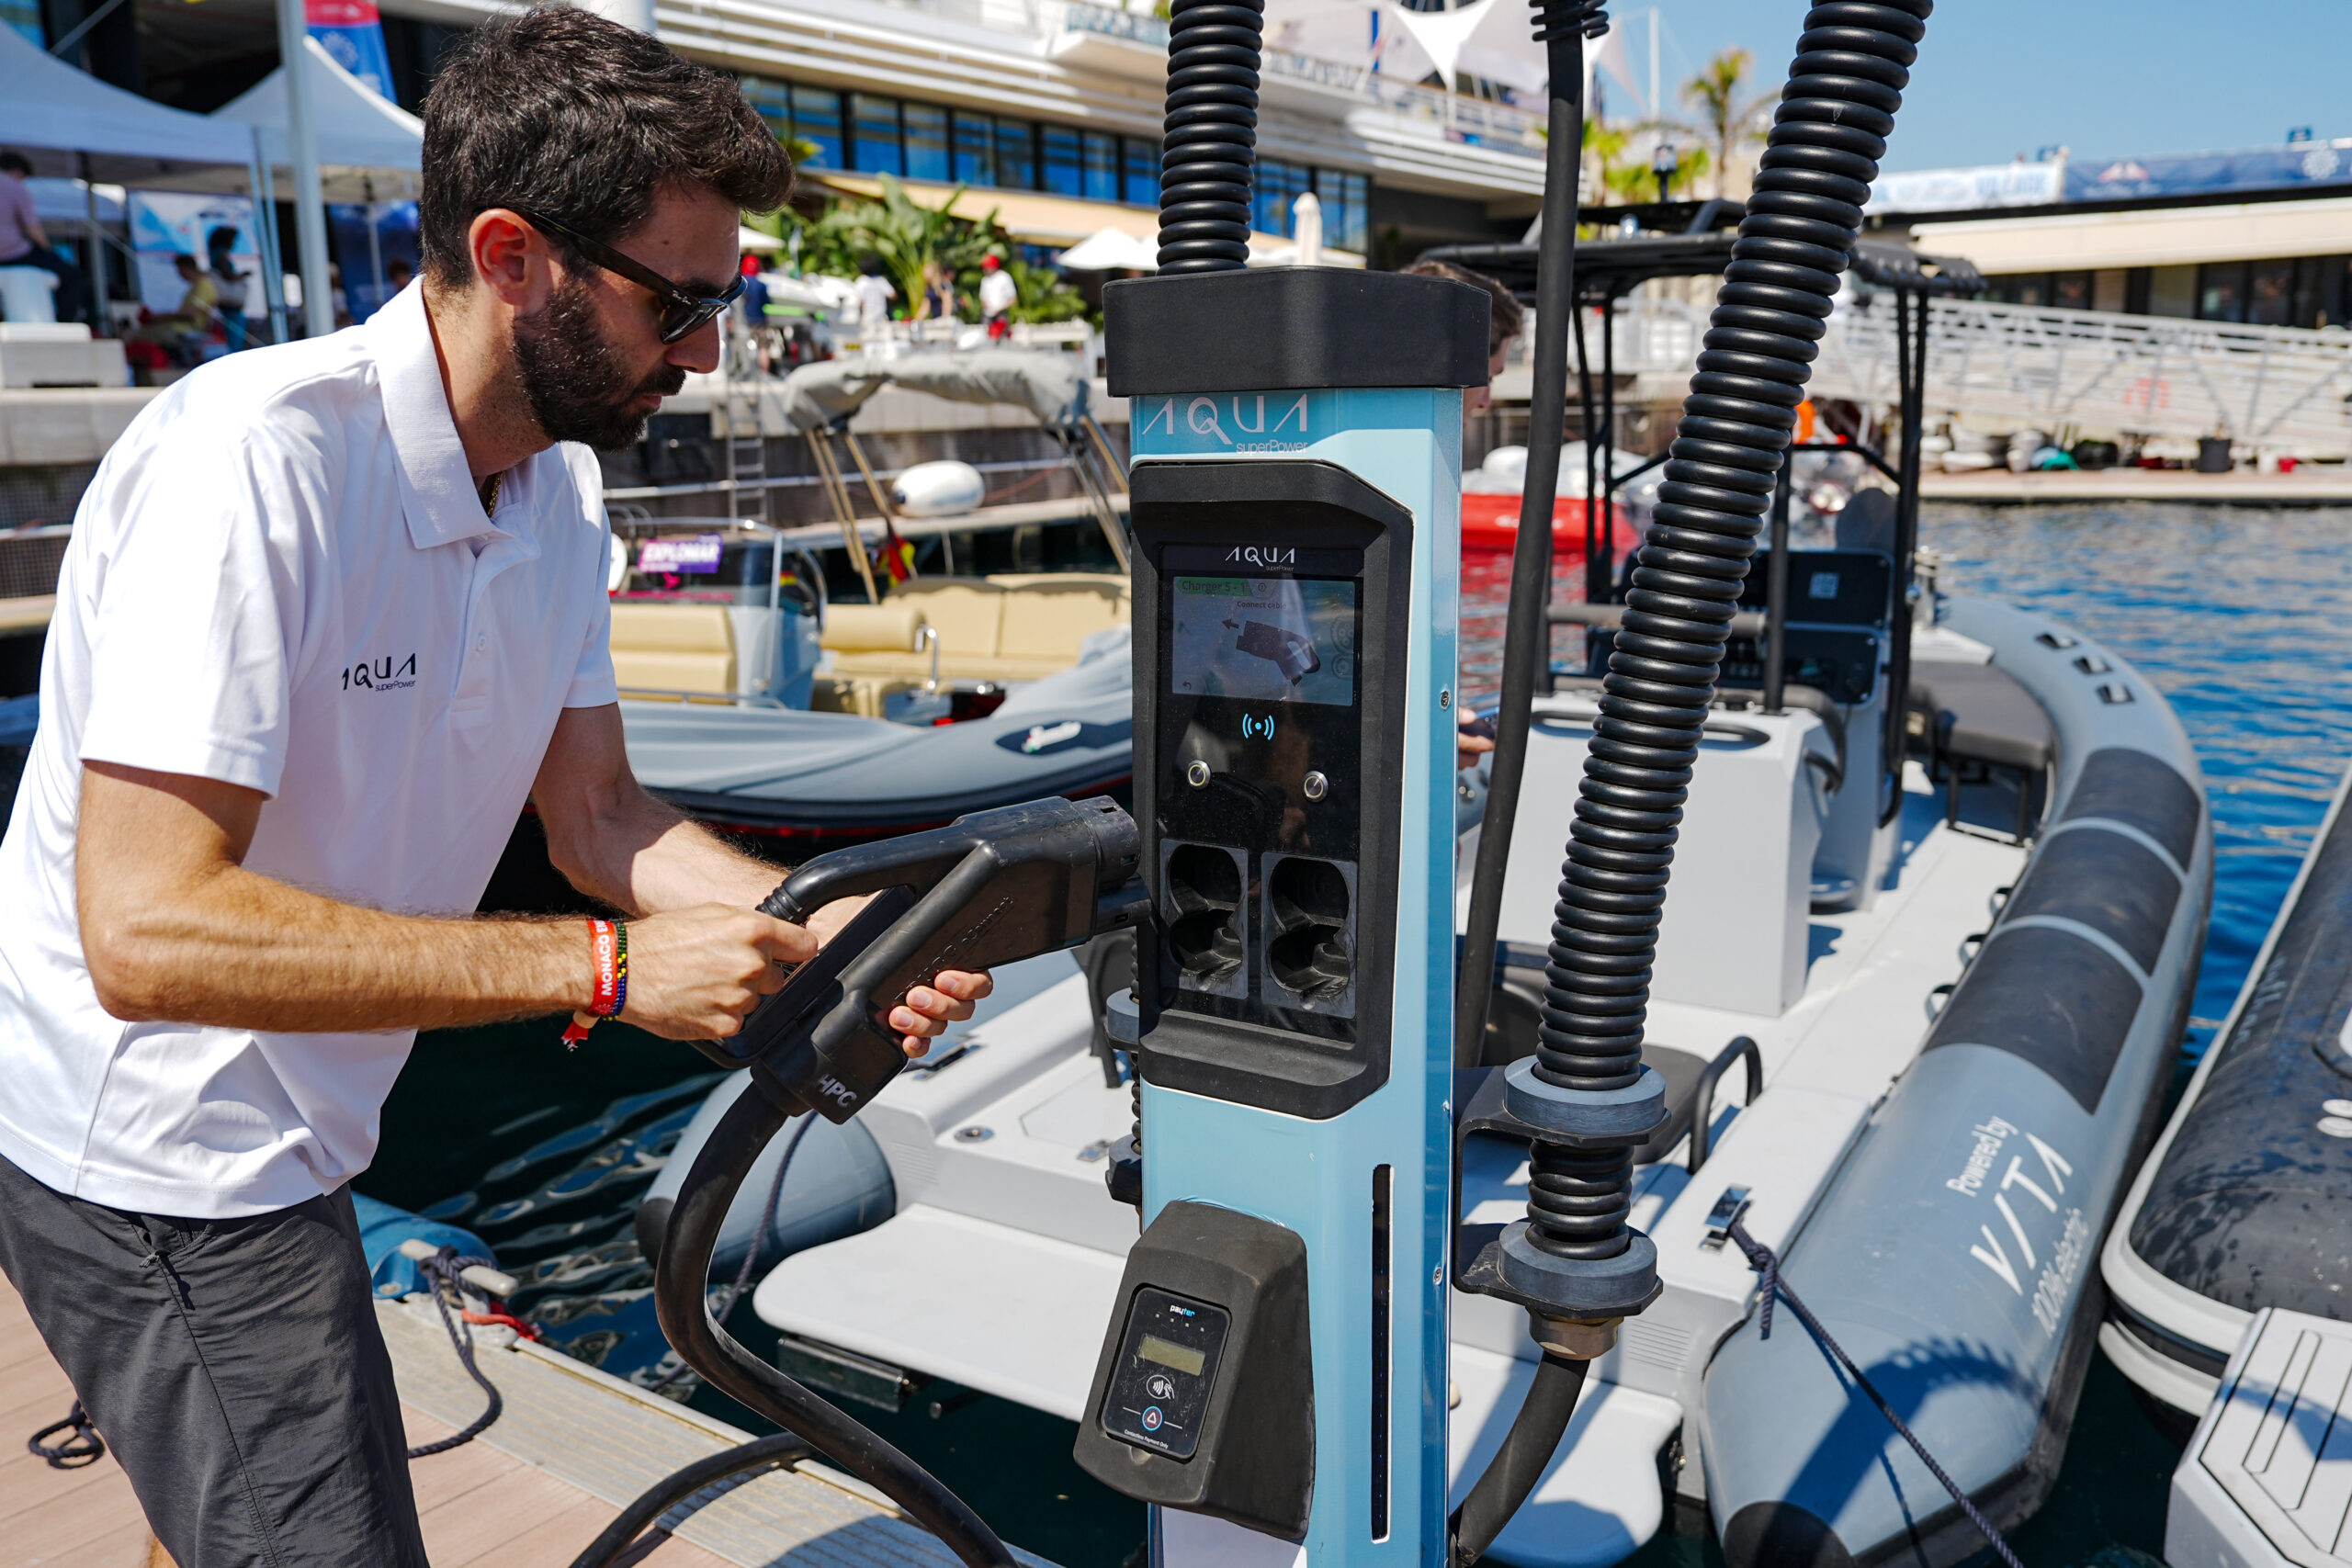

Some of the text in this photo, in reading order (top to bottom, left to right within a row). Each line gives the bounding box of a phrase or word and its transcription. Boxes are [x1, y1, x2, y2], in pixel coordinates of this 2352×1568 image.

[1142, 393, 1307, 446] AQUA
[1236, 439, 1308, 457] superPower
[1225, 546, 1295, 567] AQUA
[1182, 581, 1222, 594] Charger
[1225, 581, 1231, 592] 5
[1237, 600, 1287, 610] Connect cable
[598, 934, 613, 997] MONACO
[817, 1073, 857, 1108] HPC
[1945, 1115, 2019, 1198] Powered by
[1970, 1132, 2074, 1296] VITA
[1170, 1304, 1195, 1317] payter
